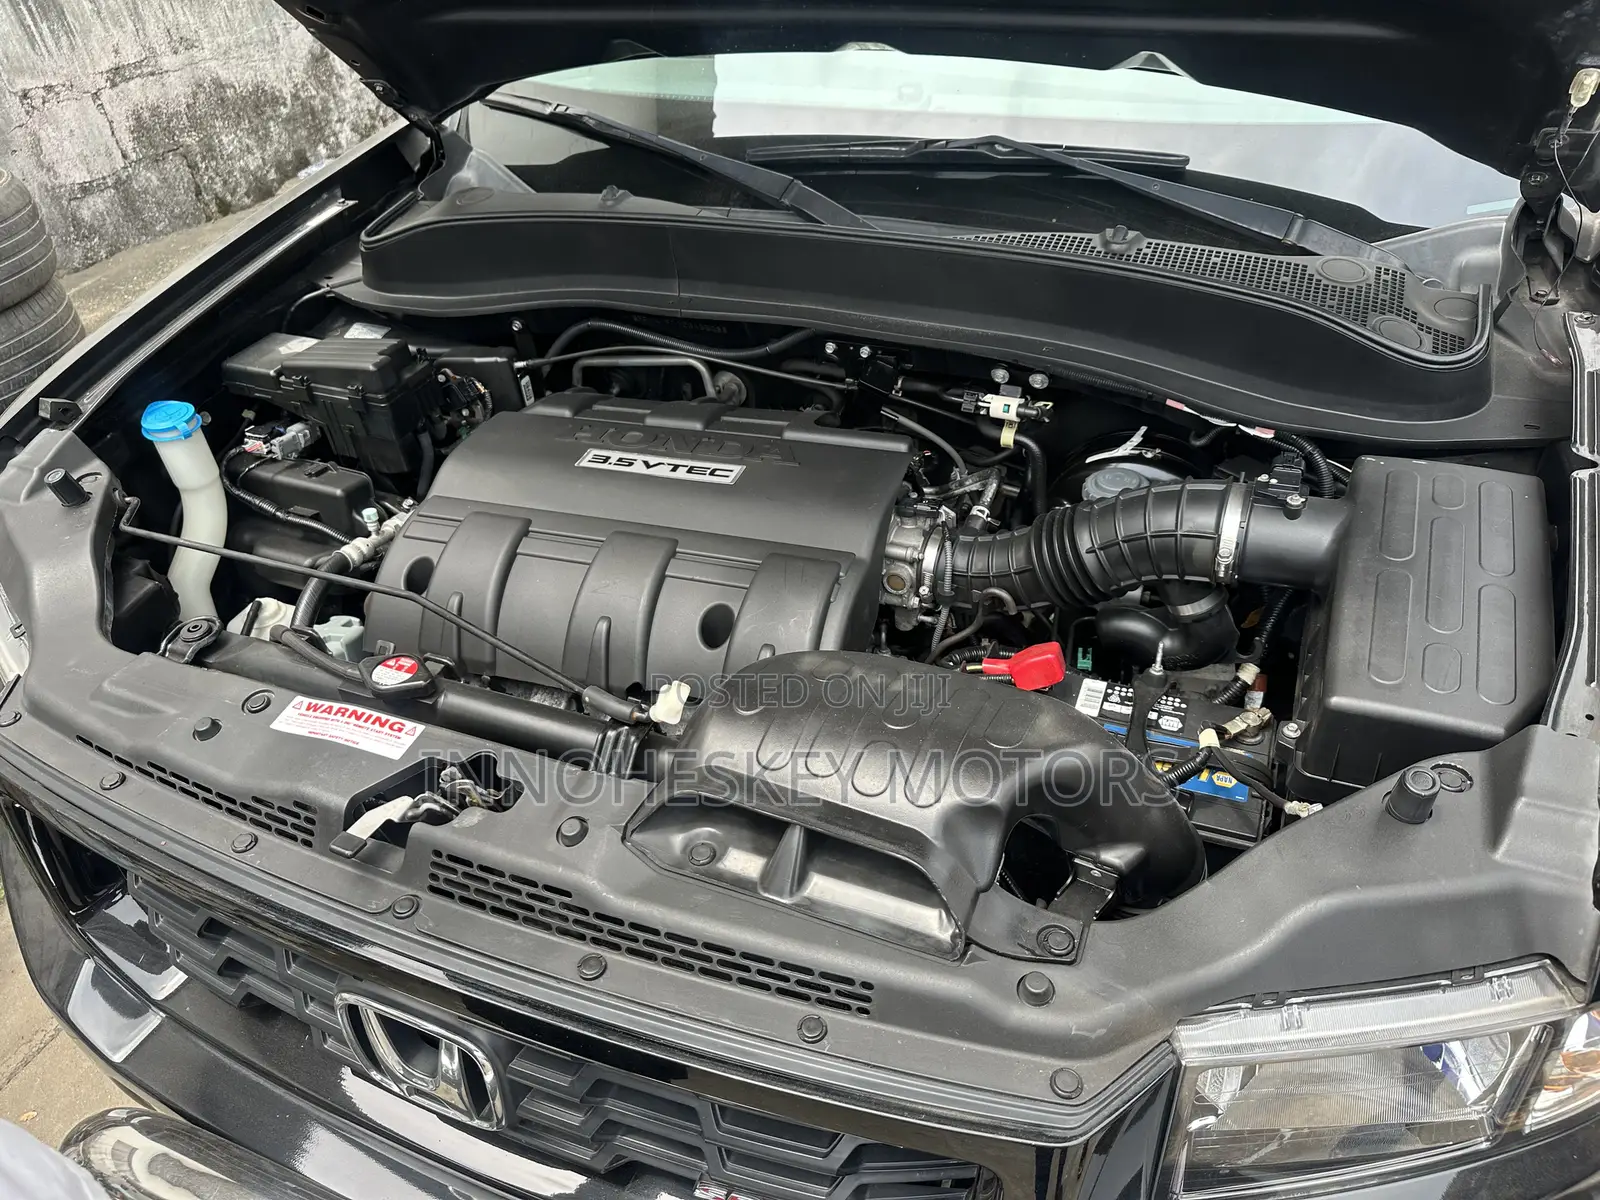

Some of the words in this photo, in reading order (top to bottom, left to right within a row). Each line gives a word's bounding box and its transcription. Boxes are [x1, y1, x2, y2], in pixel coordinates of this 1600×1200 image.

[555, 424, 800, 466] HONDA
[305, 701, 406, 733] WARNING
[1216, 773, 1234, 784] NAPA
